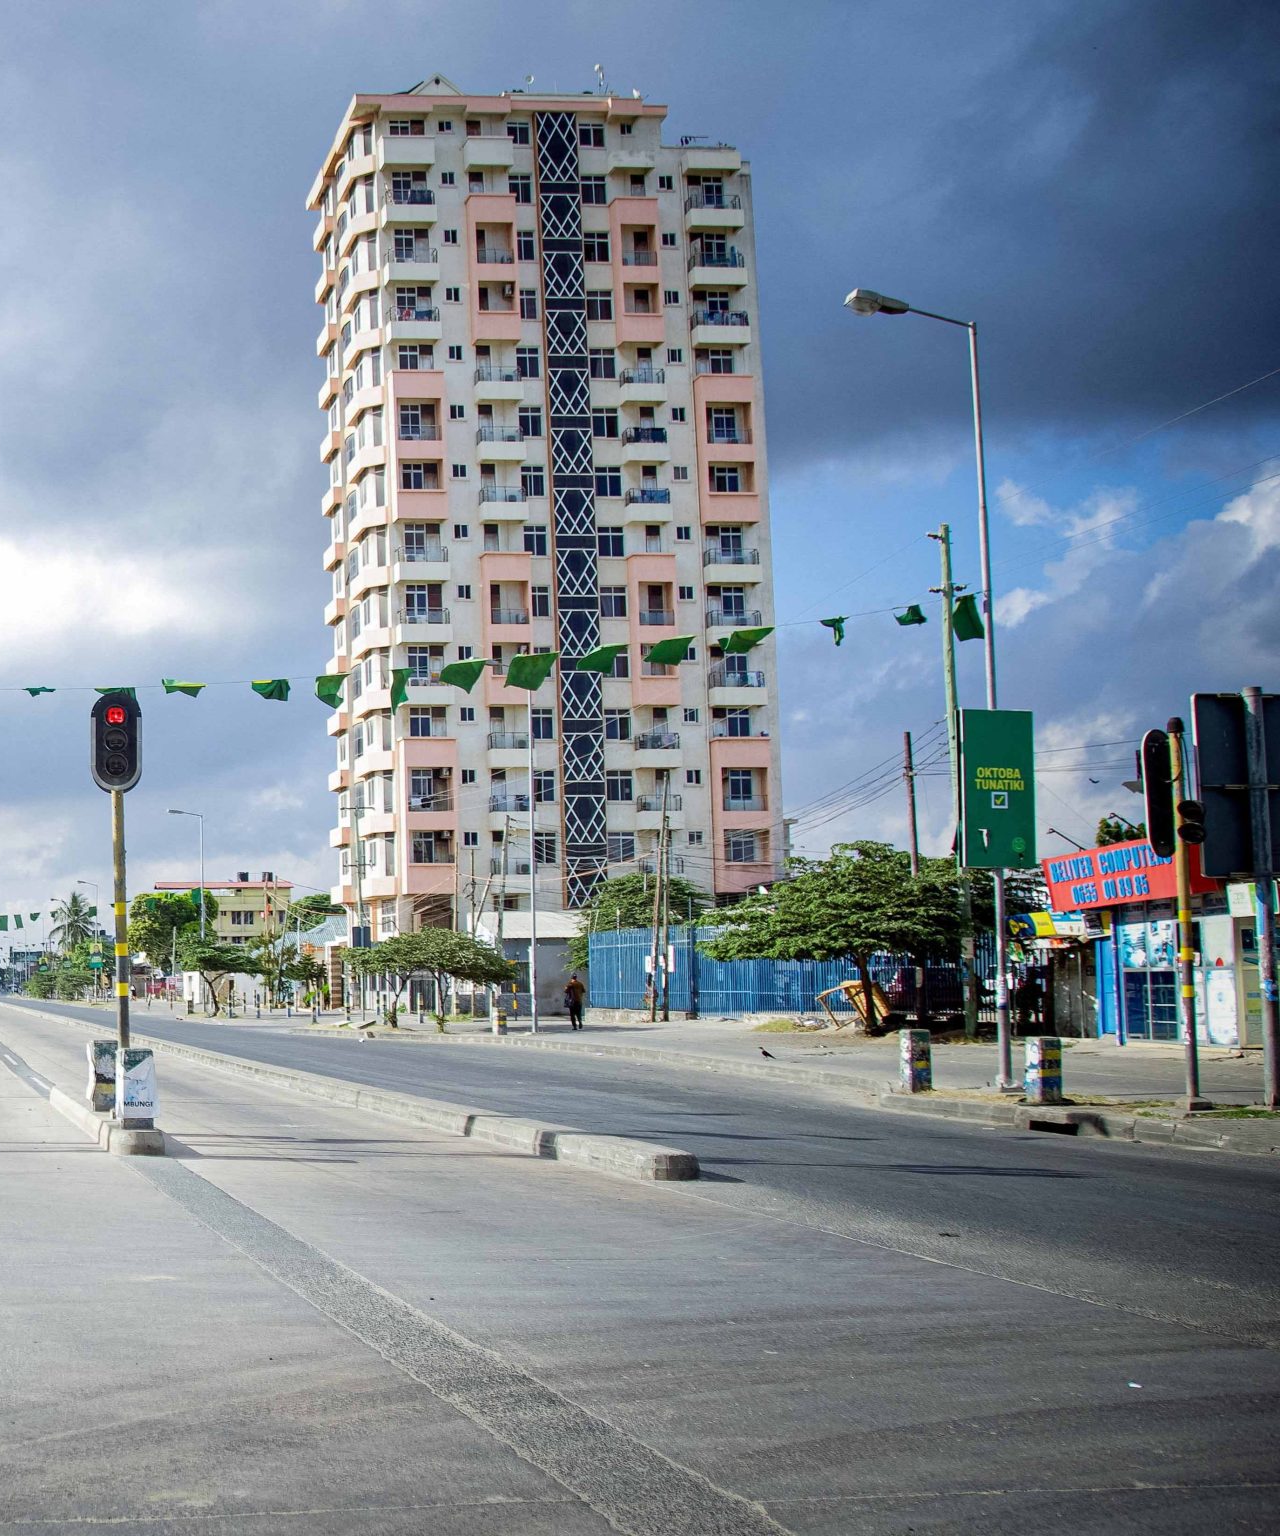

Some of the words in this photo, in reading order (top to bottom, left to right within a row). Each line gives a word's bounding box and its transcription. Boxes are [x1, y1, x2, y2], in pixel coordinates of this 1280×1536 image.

[977, 767, 1021, 778] OKTOBA
[975, 779, 1024, 790] TUNATIKI
[1098, 845, 1172, 874] COMPUTE
[1072, 883, 1097, 904] 0655
[1103, 878, 1117, 899] 00
[1119, 876, 1133, 897] 89
[1135, 874, 1149, 895] 85
